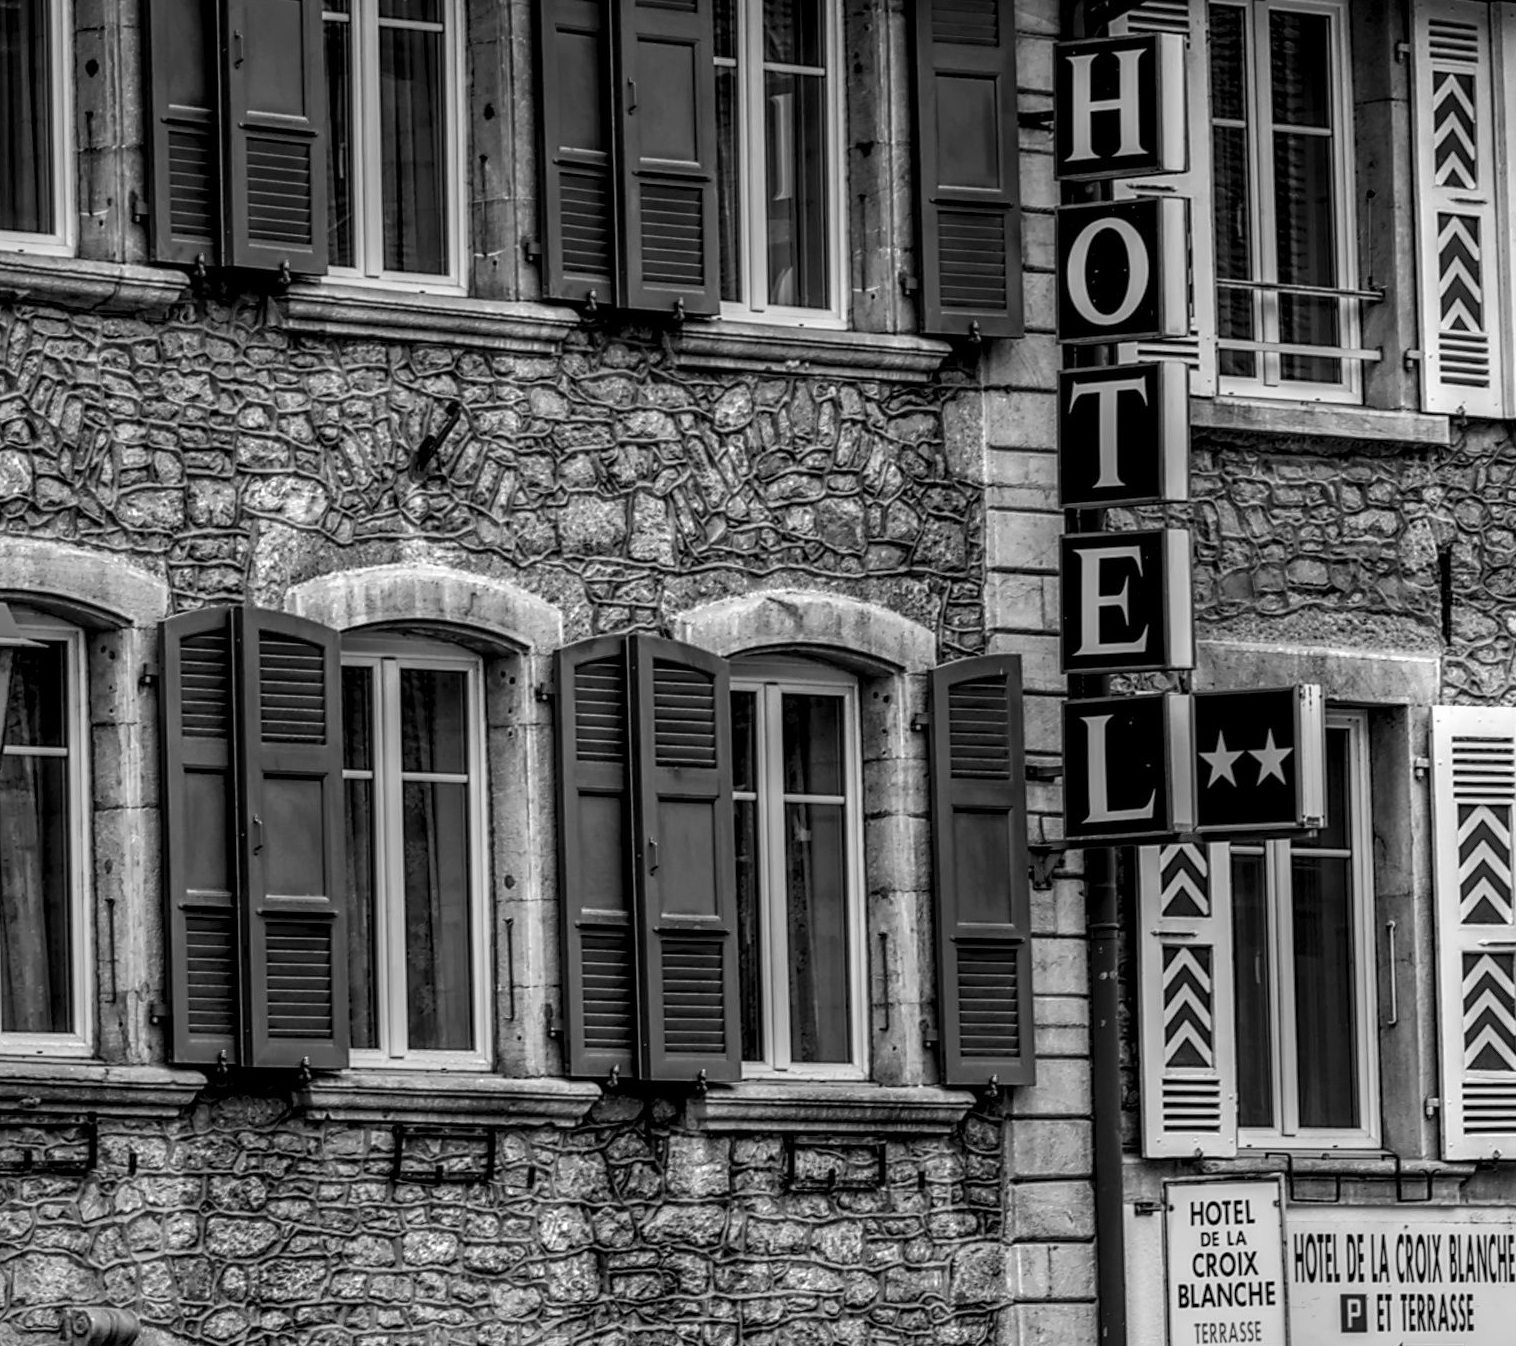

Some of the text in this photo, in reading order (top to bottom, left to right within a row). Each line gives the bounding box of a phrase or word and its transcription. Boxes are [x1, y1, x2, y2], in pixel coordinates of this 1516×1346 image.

[1065, 47, 1156, 825] HOTEL
[1190, 1199, 1256, 1227] HOTEL
[1200, 1230, 1247, 1248] DE LA
[1192, 1251, 1259, 1278] CROIX
[1293, 1233, 1516, 1284] HOTEL DE LA CROIX BLANCHE
[1178, 1281, 1276, 1309] BLANCHE
[1346, 1293, 1475, 1333] P ET TERRASSE
[1194, 1321, 1262, 1345] TERRASSE
